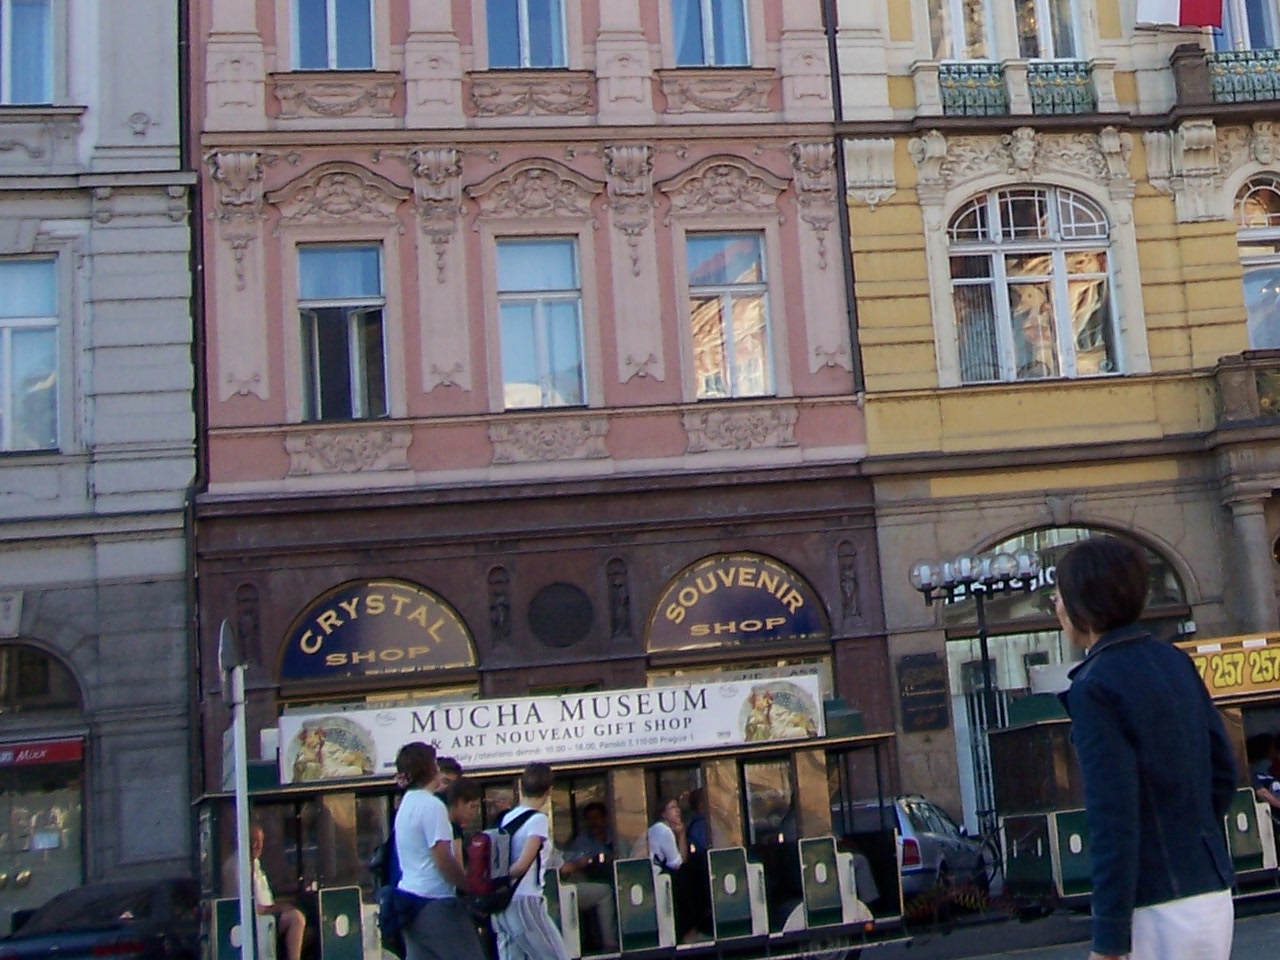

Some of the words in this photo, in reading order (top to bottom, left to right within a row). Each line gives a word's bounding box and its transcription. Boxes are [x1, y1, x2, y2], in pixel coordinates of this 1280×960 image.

[665, 566, 804, 624] SOUVENIR
[300, 594, 445, 654] CRYSTAL
[690, 617, 787, 636] SHOP
[325, 646, 430, 666] SHOP
[1210, 651, 1246, 688] 257
[410, 701, 543, 734] MUCHA
[560, 688, 708, 722] MUSEUM
[431, 739, 442, 749] &
[451, 734, 487, 749] ART
[495, 726, 585, 745] NOUVEAU
[594, 721, 636, 737] GIFT
[644, 717, 692, 732] SHOP
